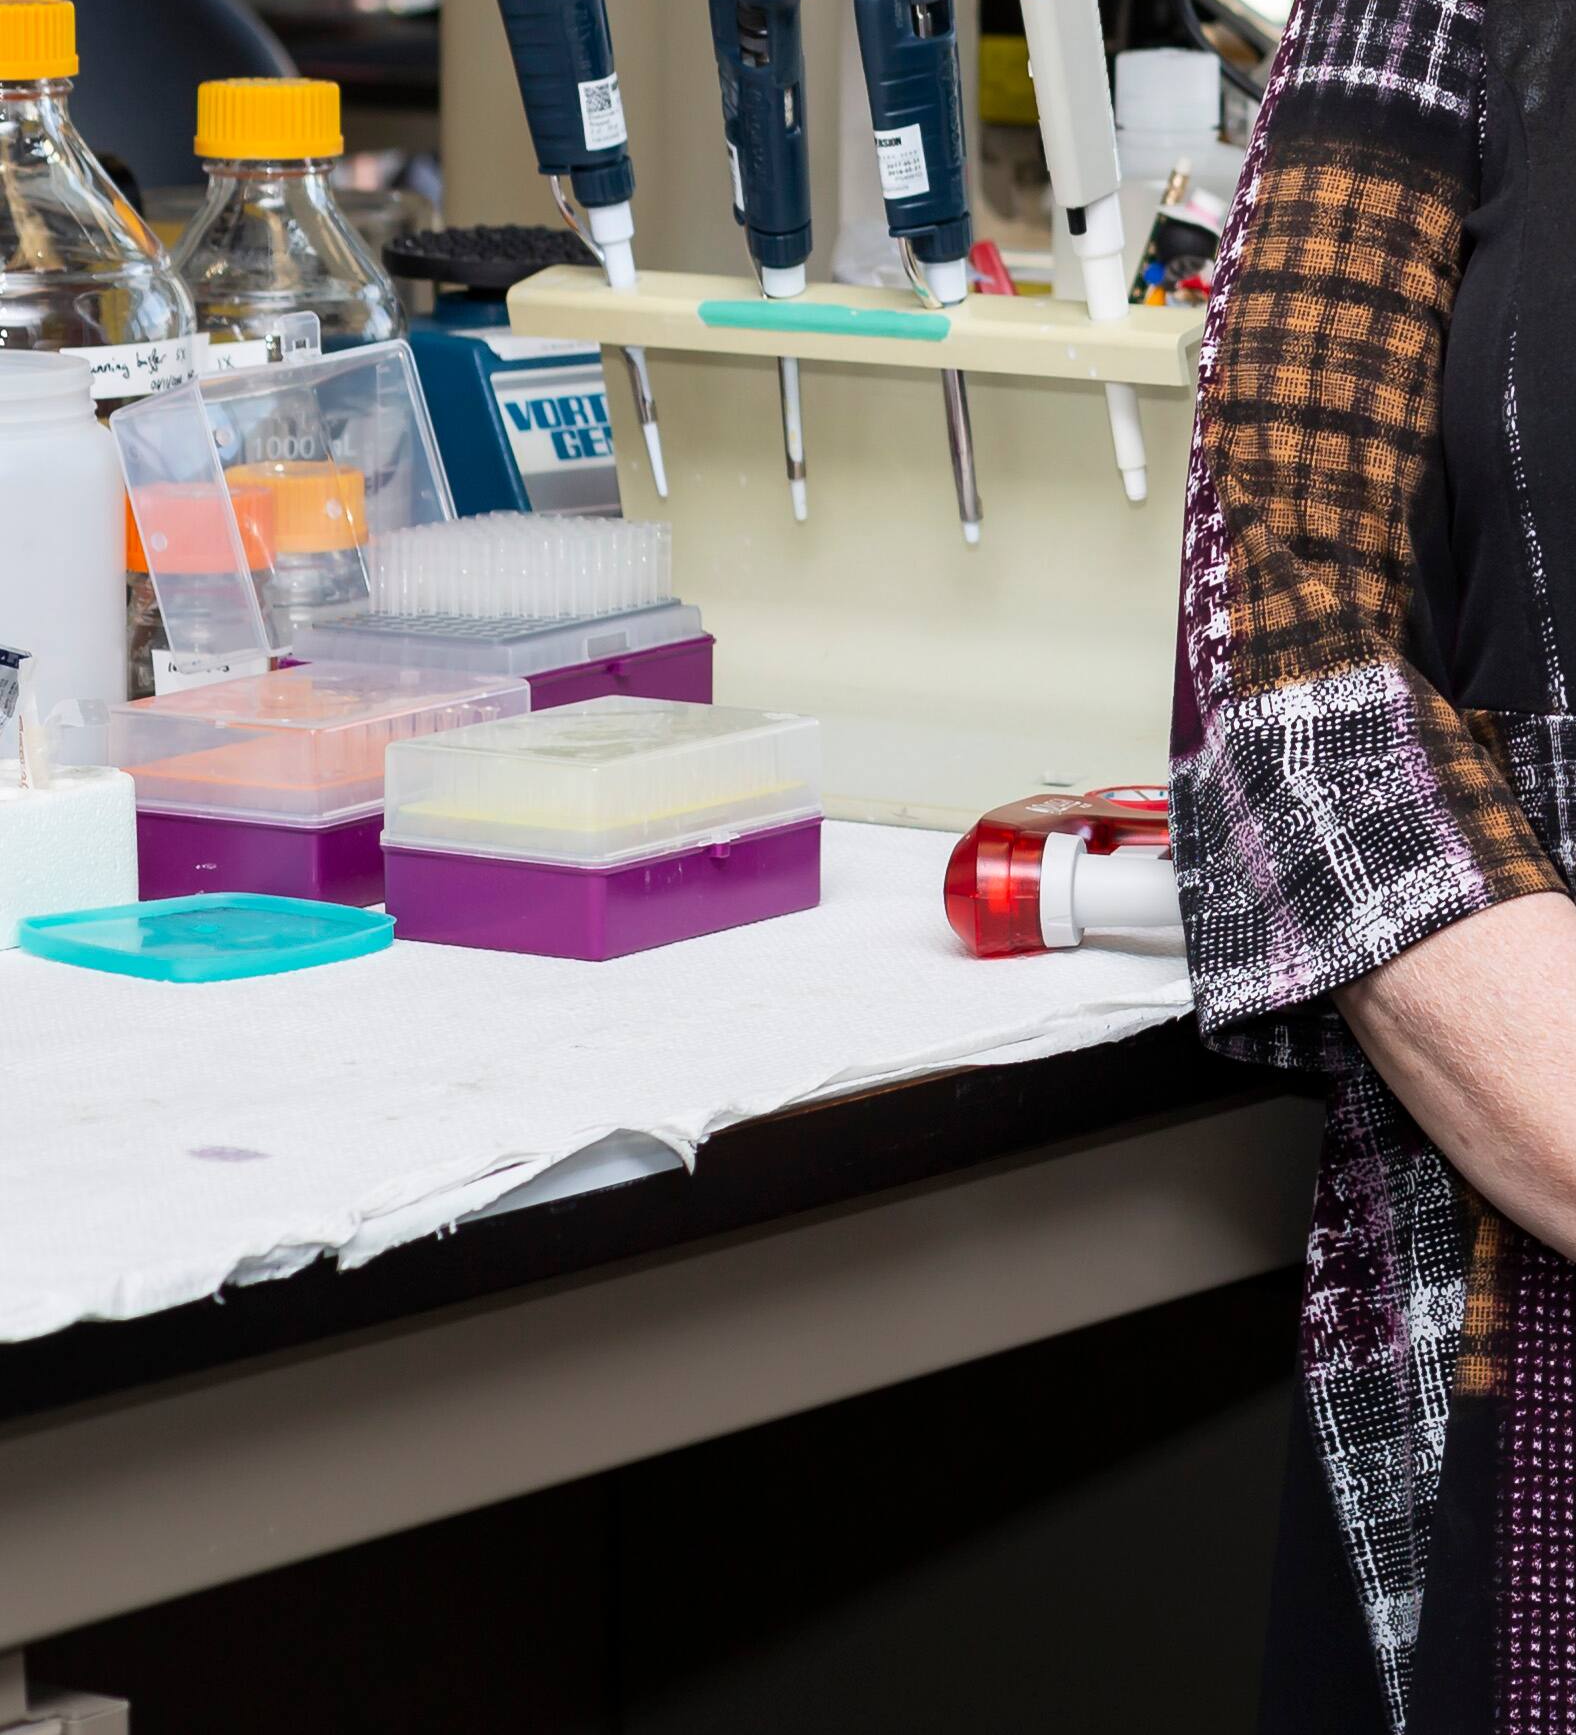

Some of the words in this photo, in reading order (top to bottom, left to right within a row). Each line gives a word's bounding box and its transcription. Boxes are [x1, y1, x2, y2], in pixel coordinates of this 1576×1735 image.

[90, 357, 130, 380] unning
[136, 347, 167, 375] buffer
[255, 435, 315, 460] 1000
